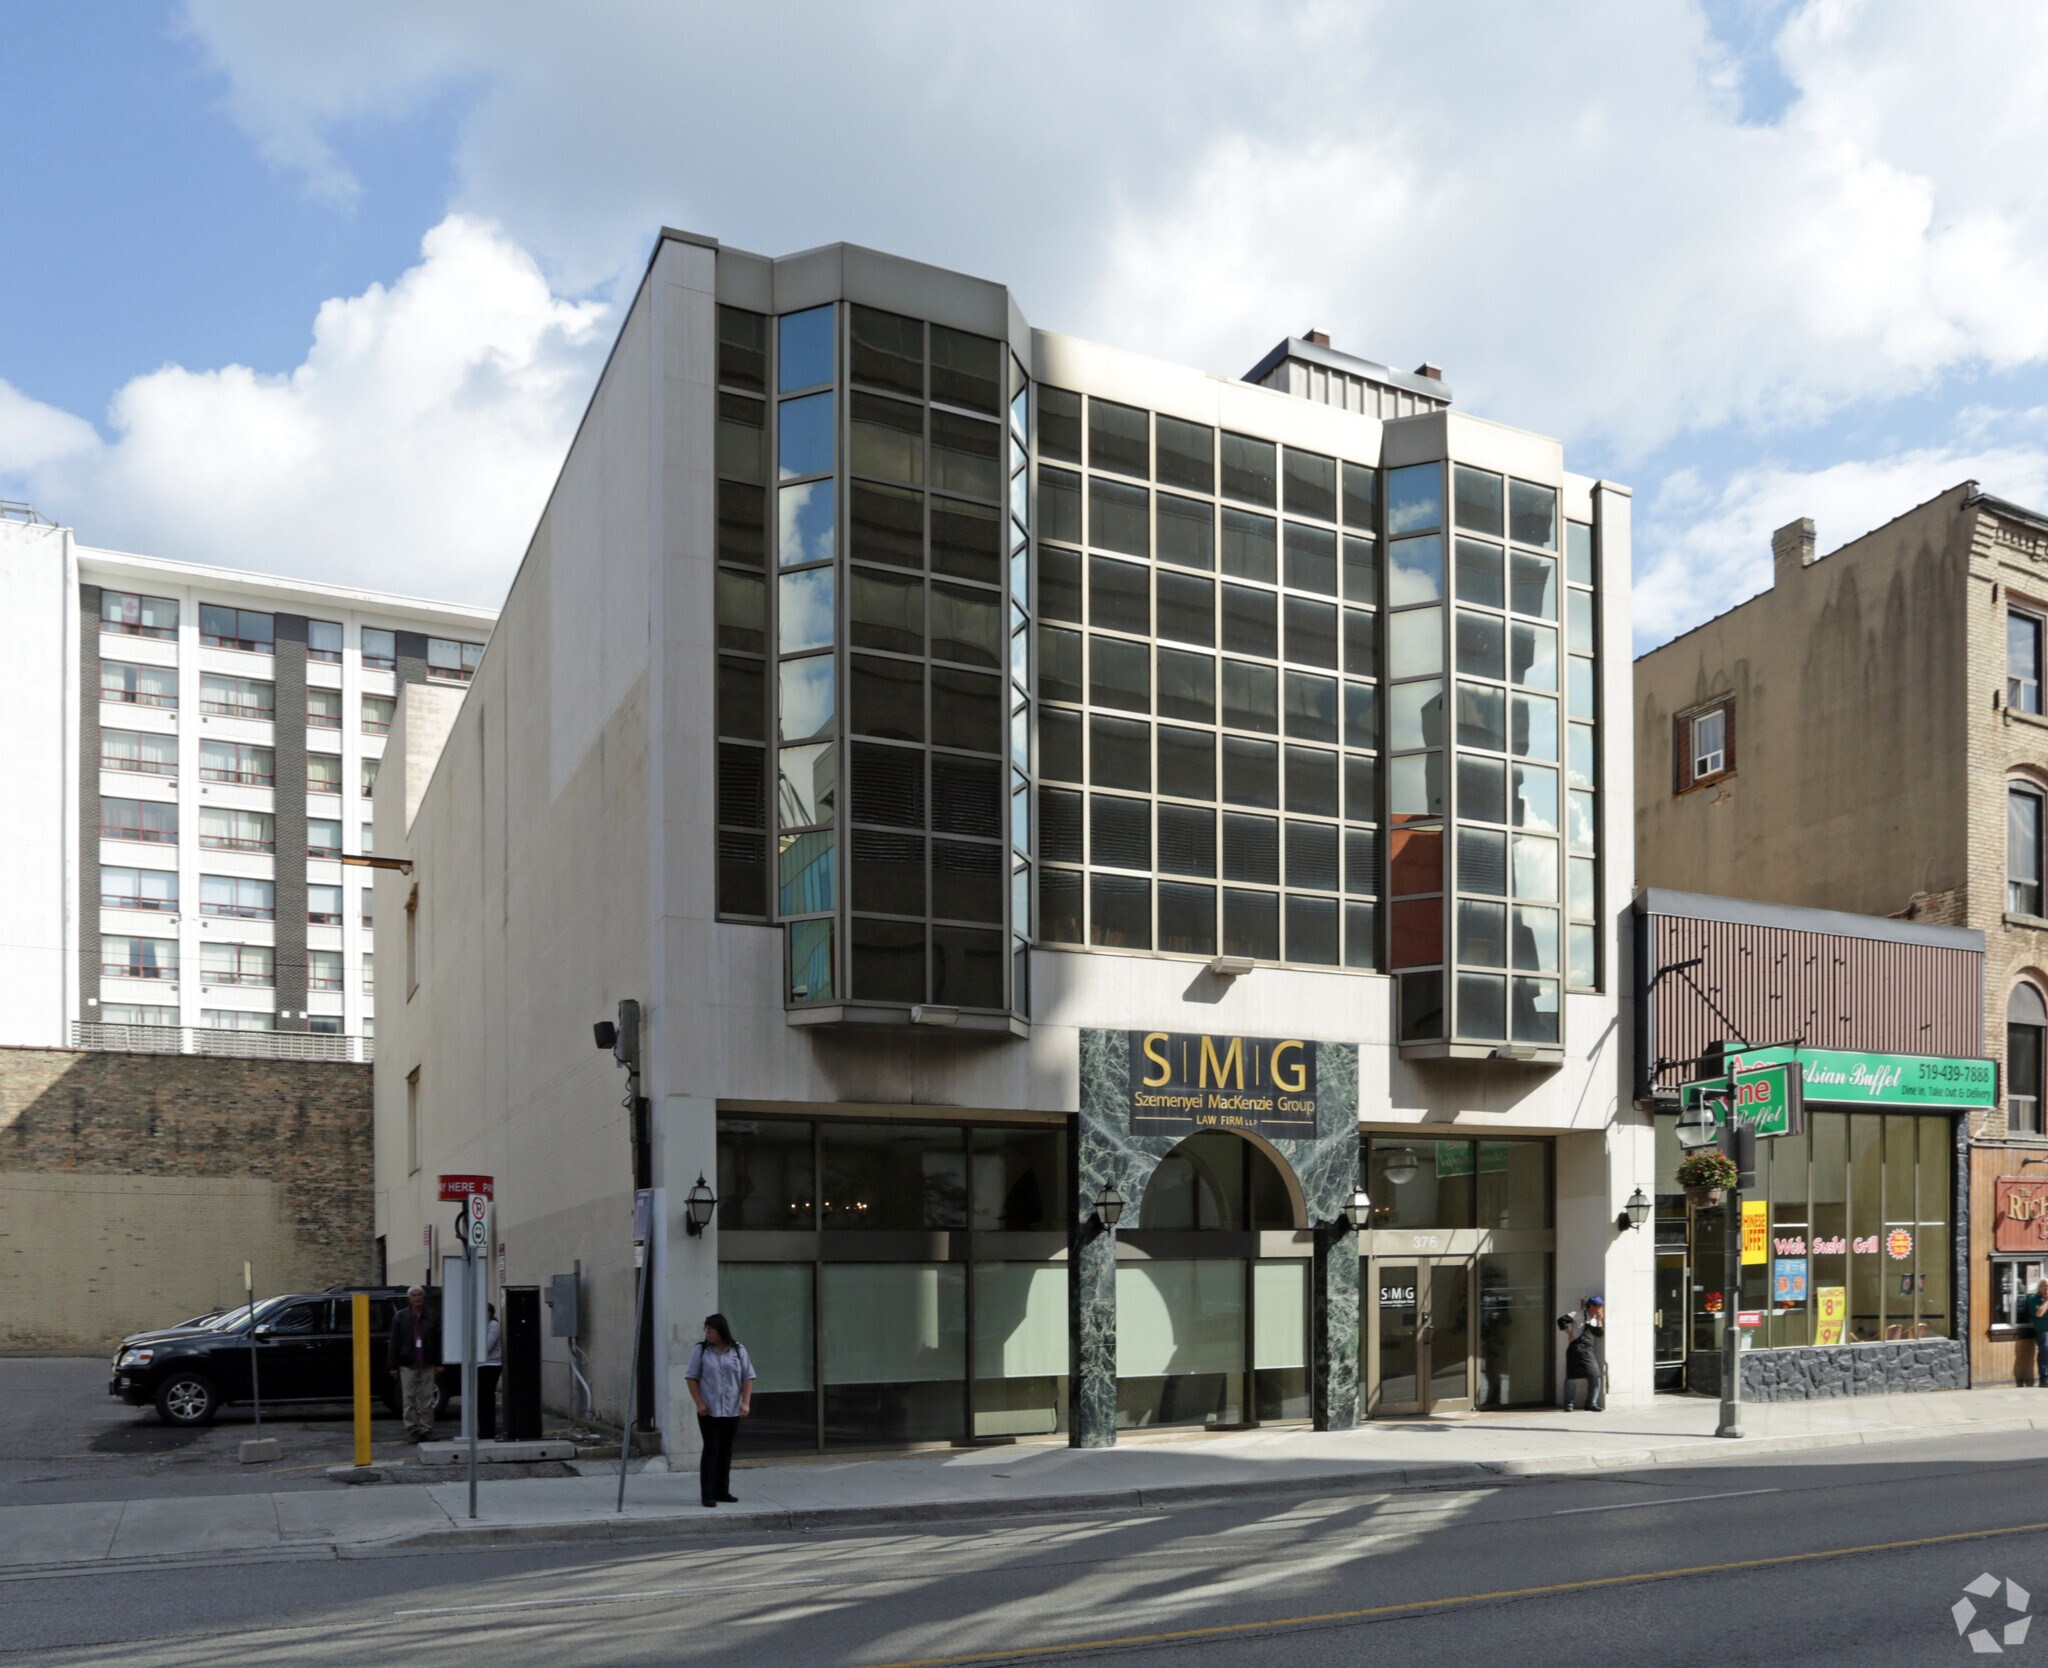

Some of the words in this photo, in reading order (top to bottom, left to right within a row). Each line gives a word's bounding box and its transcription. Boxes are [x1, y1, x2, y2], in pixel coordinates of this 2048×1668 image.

[1802, 1060, 1847, 1085] Asian
[1848, 1063, 1903, 1096] Buffet
[1919, 1063, 1990, 1083] 519-439-7888
[1901, 1084, 1917, 1096] Dine
[1928, 1086, 1944, 1097] Take
[1945, 1087, 1959, 1098] Out
[1966, 1088, 1992, 1102] Delivery
[1134, 1091, 1204, 1112] Szemenyei
[1207, 1094, 1274, 1111] MacKenzie
[1277, 1096, 1315, 1116] Group
[1195, 1115, 1218, 1125] LAW
[1220, 1115, 1244, 1126] FIRM
[448, 1182, 475, 1193] HERE
[1742, 1214, 1765, 1228] HINESE
[1412, 1235, 1440, 1249] 376
[1742, 1229, 1765, 1251] UFFET
[1773, 1236, 1807, 1255] Wok
[1811, 1235, 1847, 1255] Sushi
[1852, 1235, 1879, 1254] Grill
